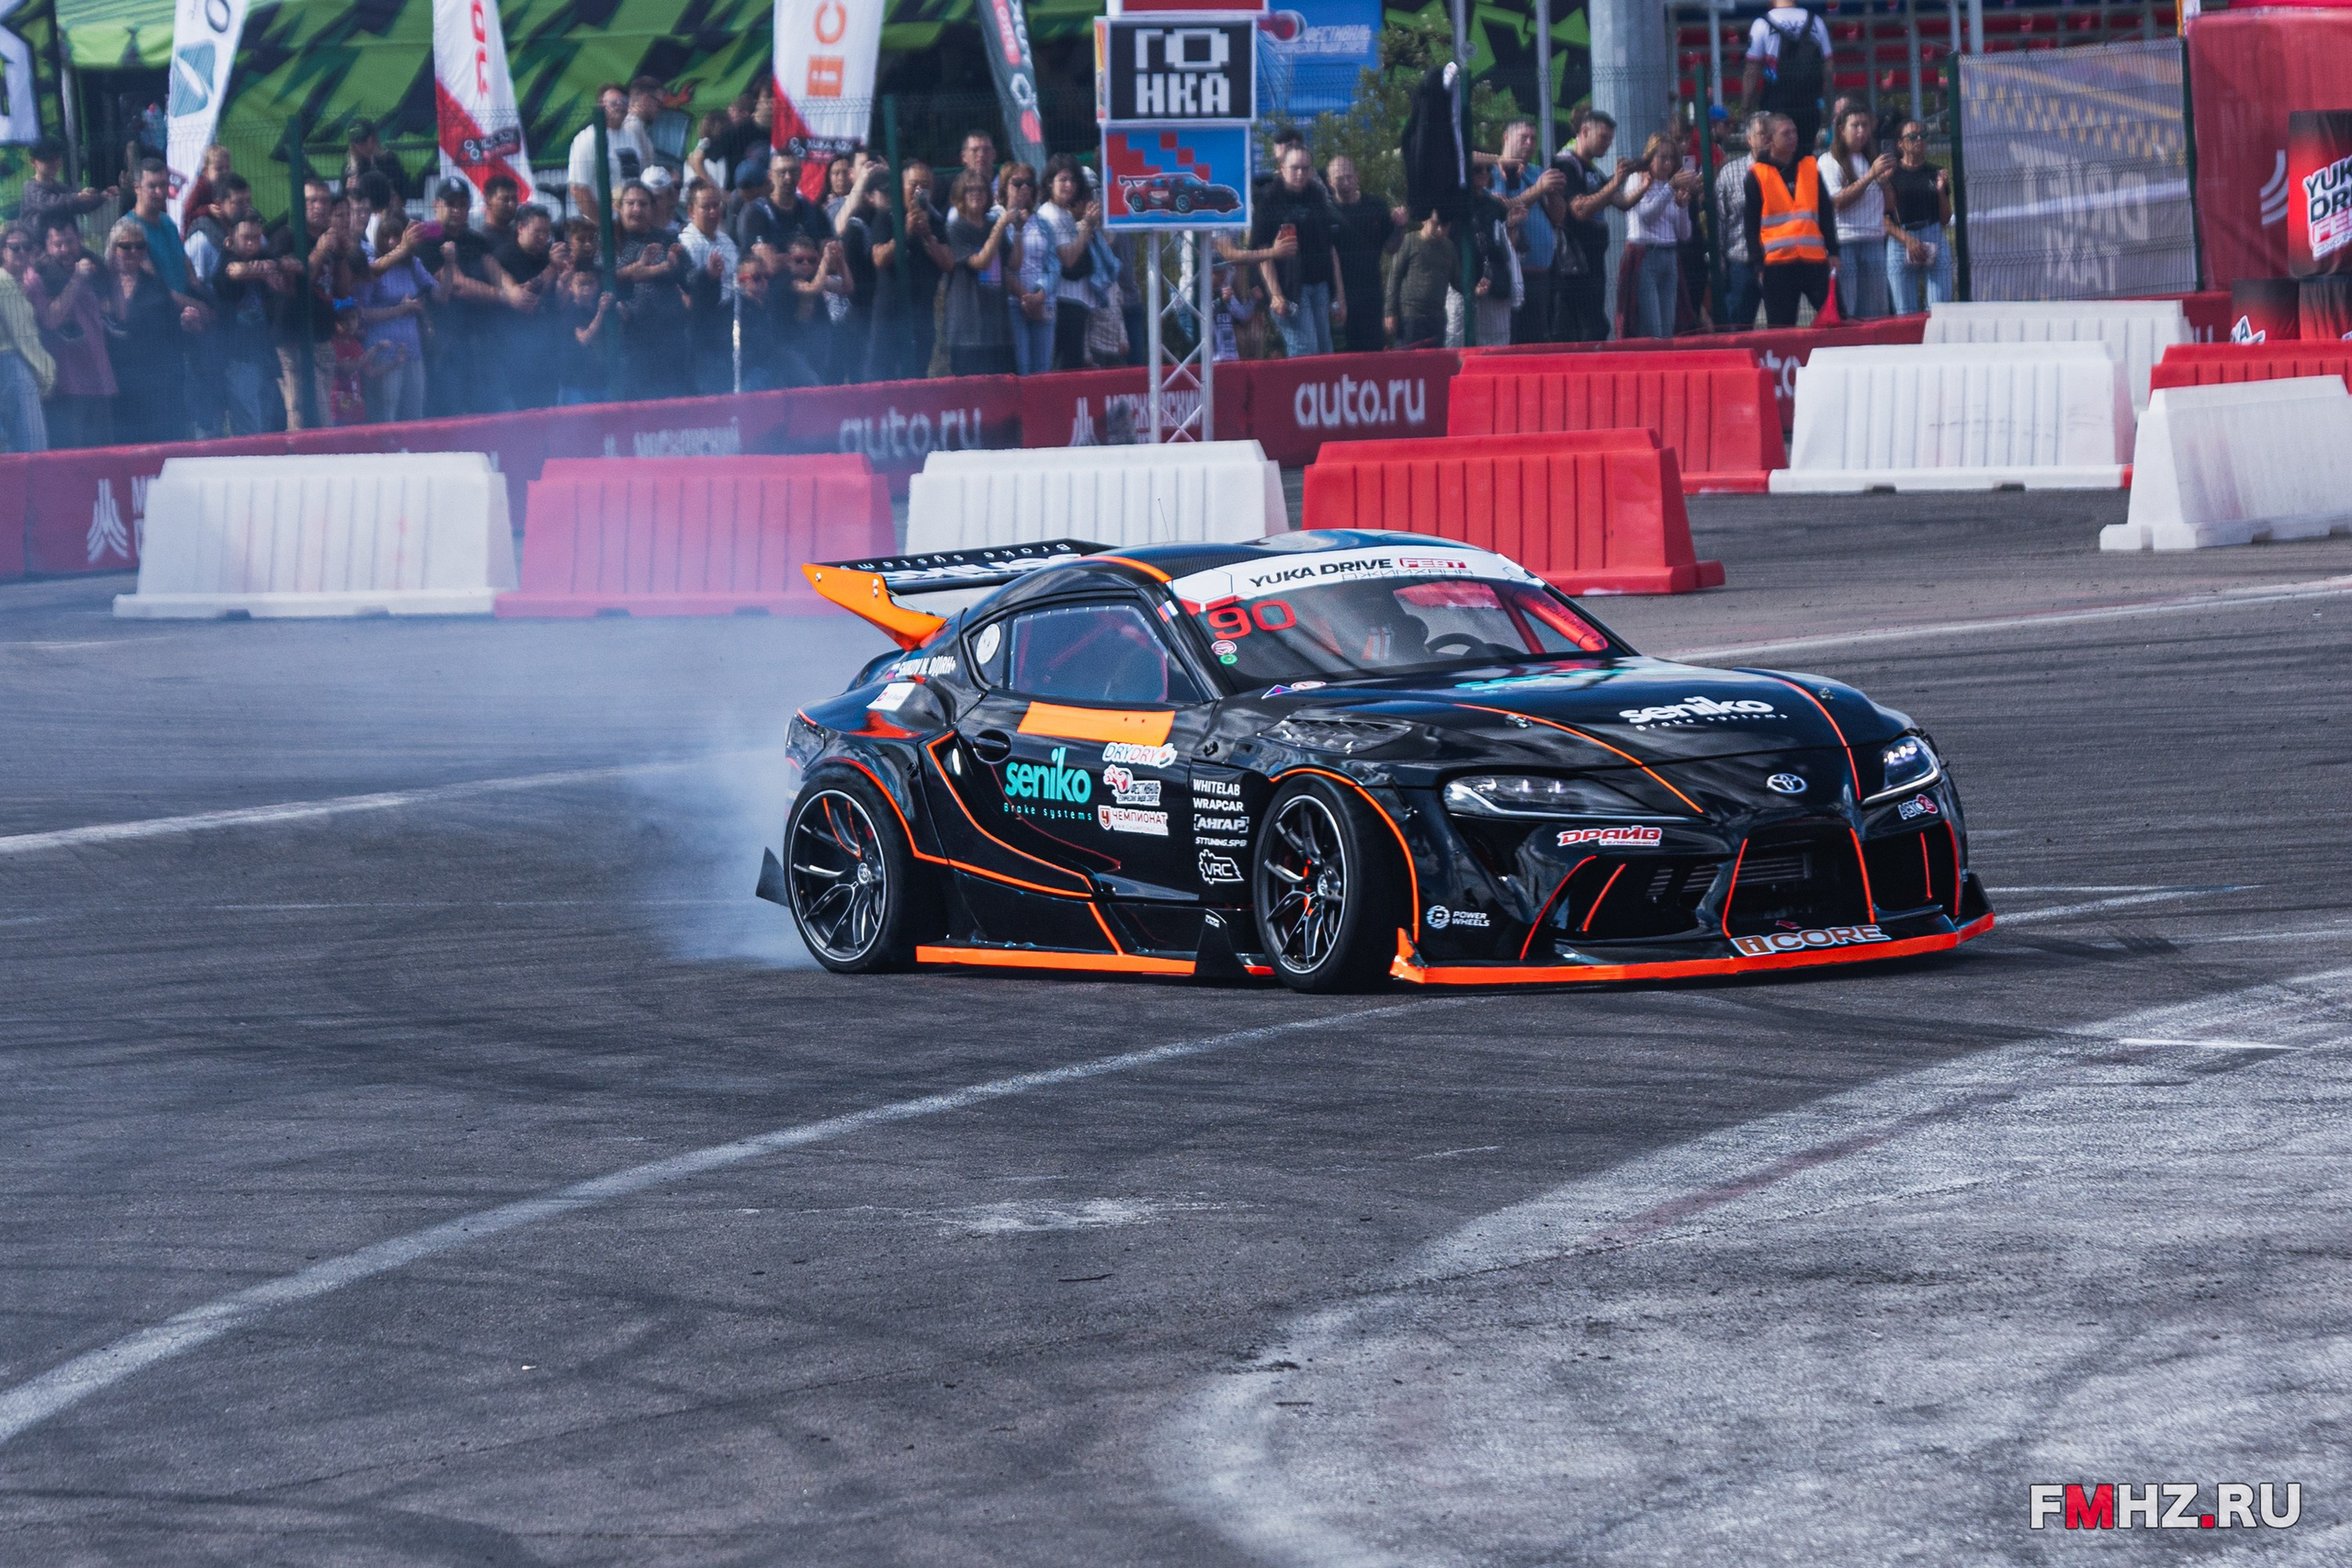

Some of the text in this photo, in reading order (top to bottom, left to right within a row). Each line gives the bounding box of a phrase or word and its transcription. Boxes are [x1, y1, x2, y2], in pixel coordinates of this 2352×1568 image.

[1136, 28, 1229, 69] ГО
[1136, 73, 1230, 113] НКА
[1295, 373, 1425, 427] auto.ru
[839, 406, 981, 459] auto.ru
[1250, 557, 1467, 588] YUKA DRIVE FEST
[1207, 599, 1297, 640] 90
[1619, 695, 1774, 723] seniko
[1004, 747, 1092, 804] seniko
[1193, 779, 1241, 796] WHITELAB
[1043, 808, 1092, 821] systems
[1112, 810, 1166, 825] ЧЕМПИОНАТ
[1193, 797, 1245, 812] WRAPCAR
[1558, 826, 1661, 844] ДРАЙВ
[1452, 918, 1491, 927] WHEELS
[1453, 910, 1487, 919] POWER
